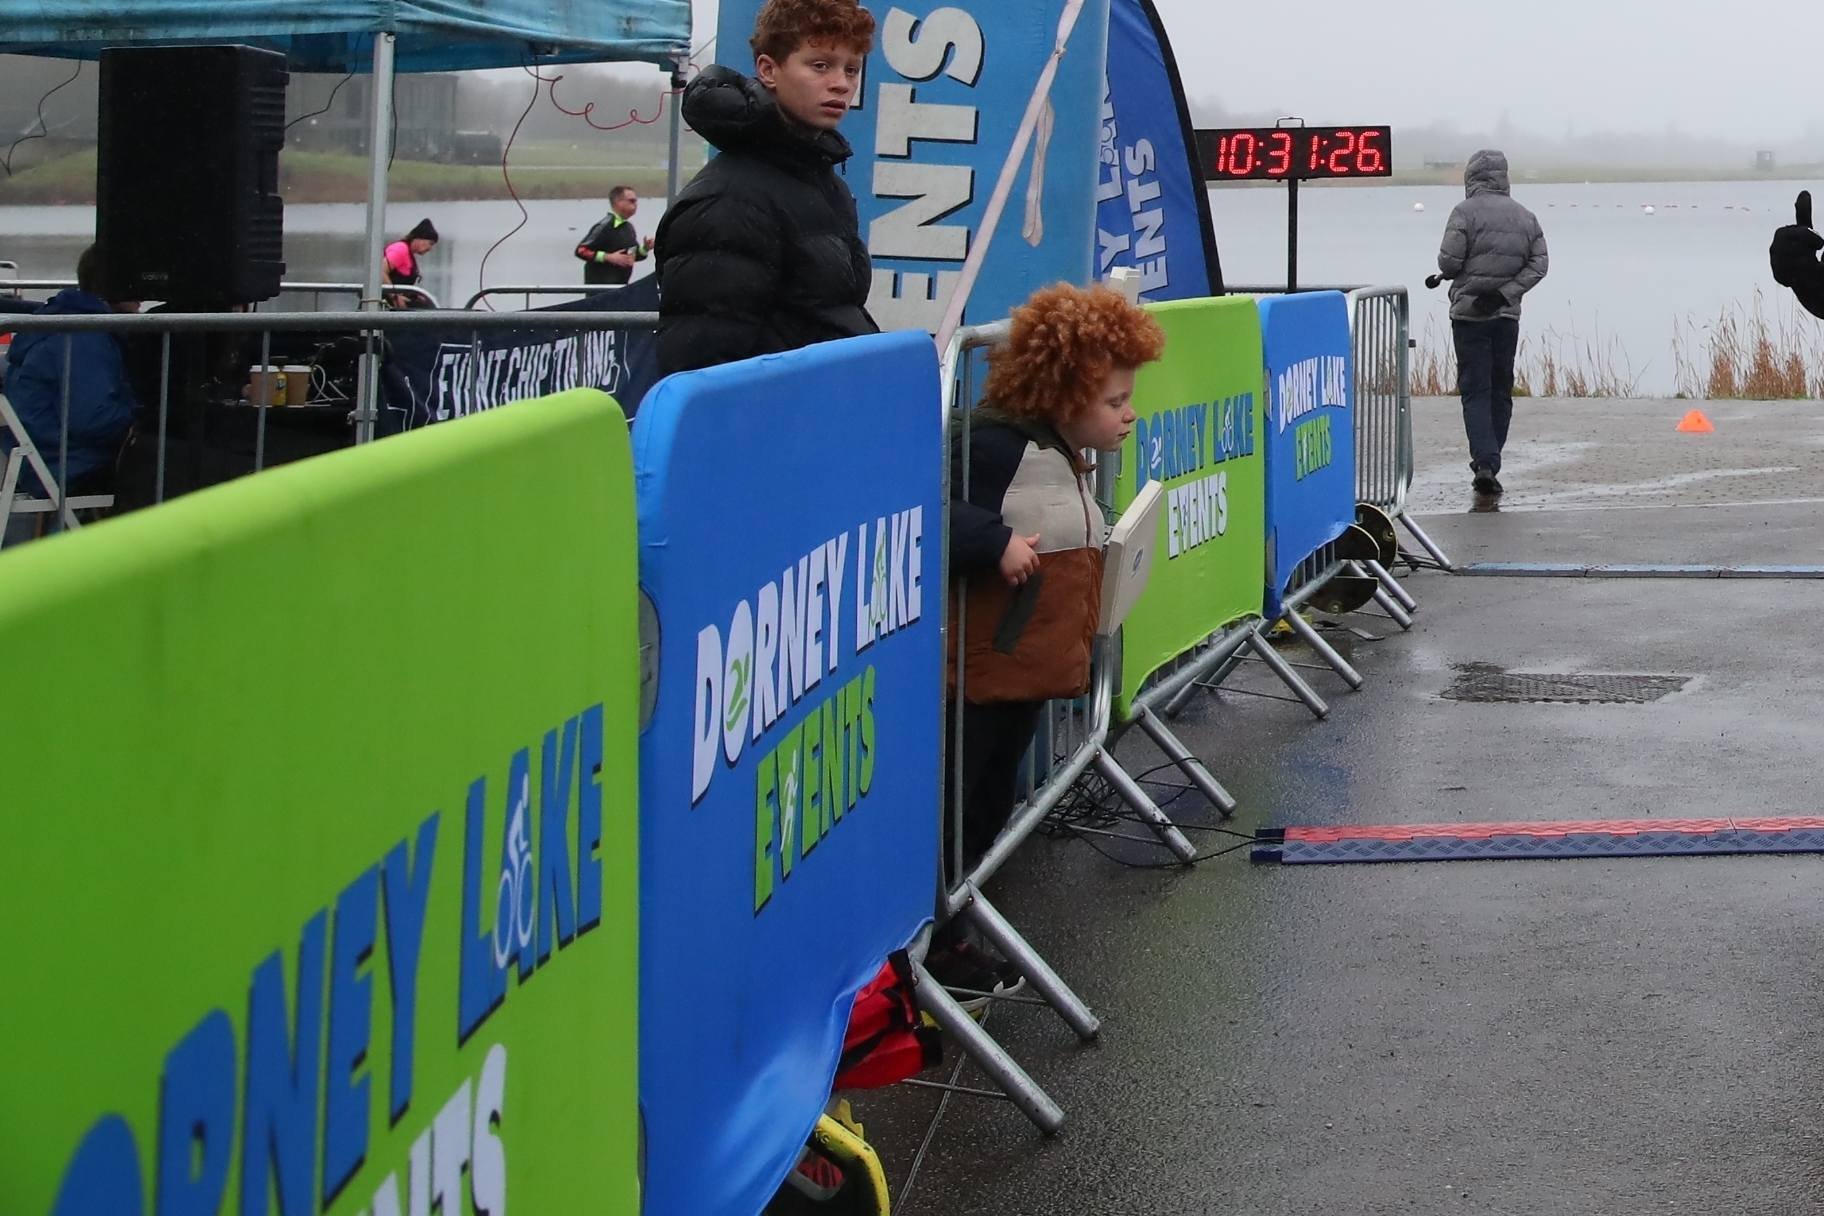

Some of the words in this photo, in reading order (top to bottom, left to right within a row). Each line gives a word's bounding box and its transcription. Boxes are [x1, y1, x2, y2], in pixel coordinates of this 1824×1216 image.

[865, 6, 985, 337] ENTS
[1135, 403, 1208, 493] DORNEY
[1213, 392, 1254, 464] LAKE
[1279, 357, 1318, 434] DORNEY
[1321, 355, 1347, 409] LAKE
[1295, 414, 1332, 482] EVENTS
[1168, 471, 1228, 560] EVENTS
[692, 531, 849, 810] DORNEY
[856, 505, 923, 656] LAKE
[457, 703, 604, 1048] LAKE
[754, 665, 876, 918] EVENTS
